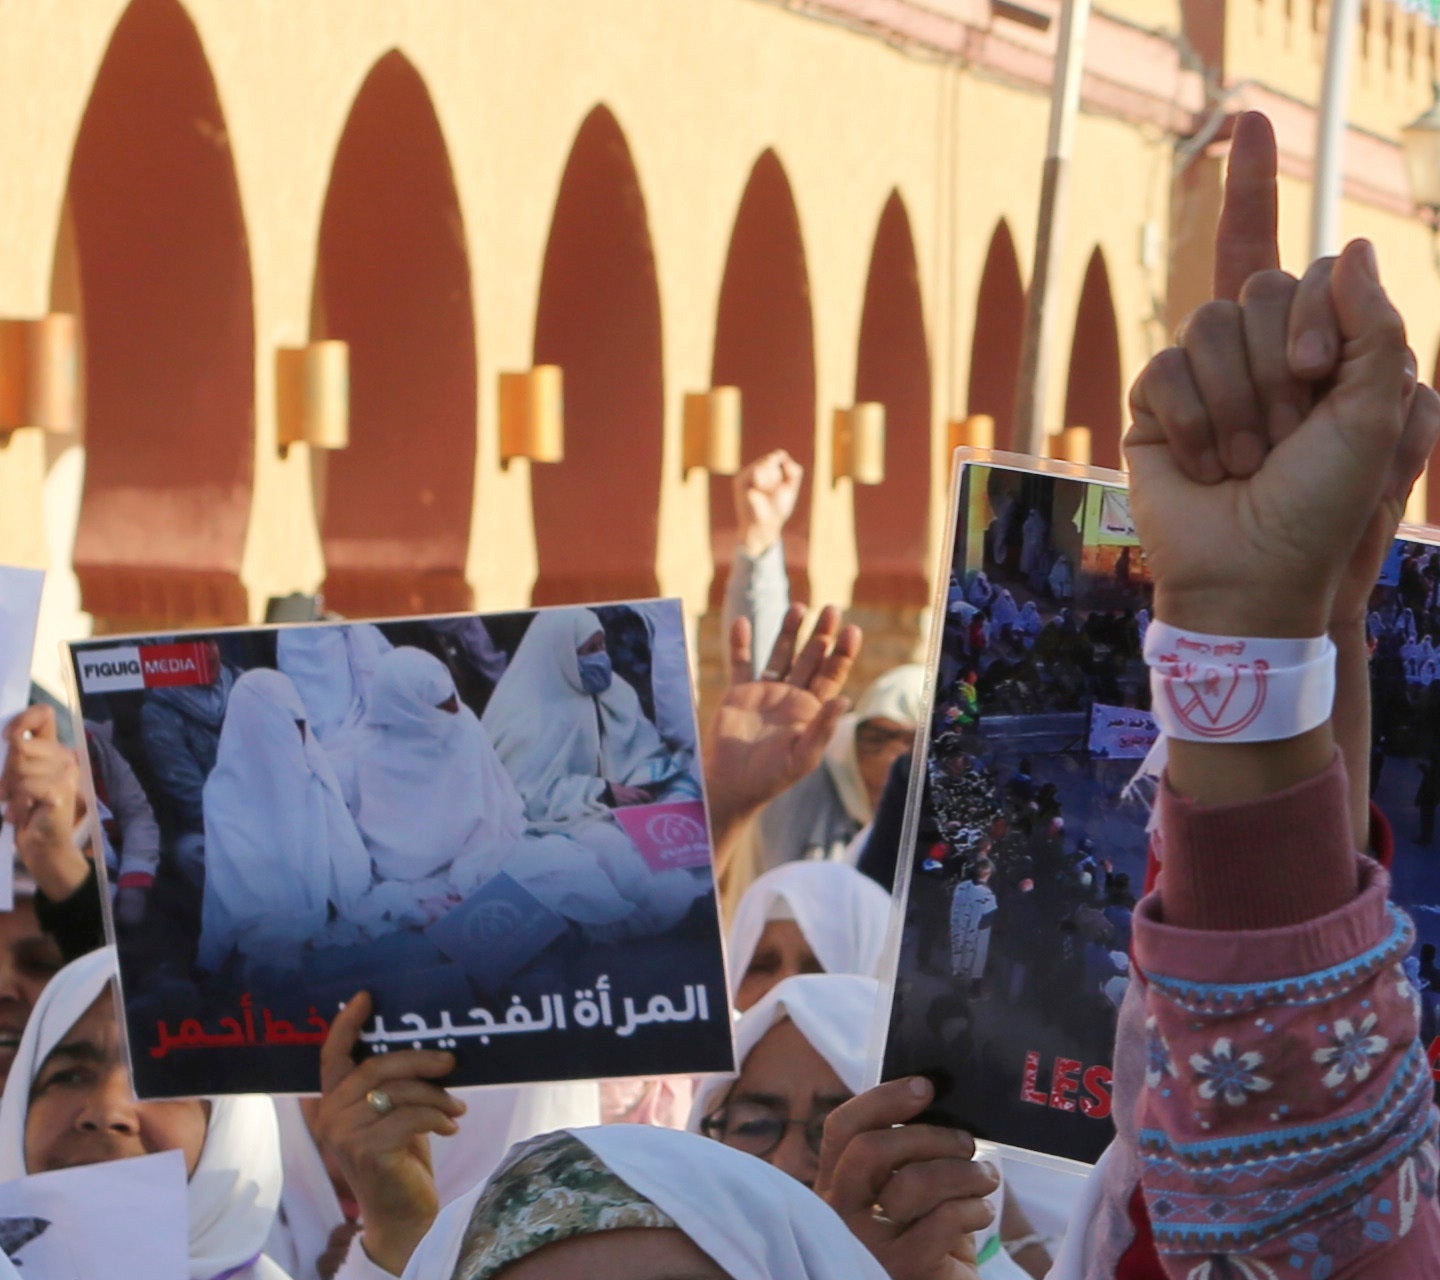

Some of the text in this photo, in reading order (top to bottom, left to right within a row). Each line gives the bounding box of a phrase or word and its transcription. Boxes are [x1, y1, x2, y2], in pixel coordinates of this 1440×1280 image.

[144, 658, 196, 673] MEDIA
[150, 974, 709, 1058] المرأة الفجيجي خط أحمر
[1020, 1050, 1114, 1119] LES
